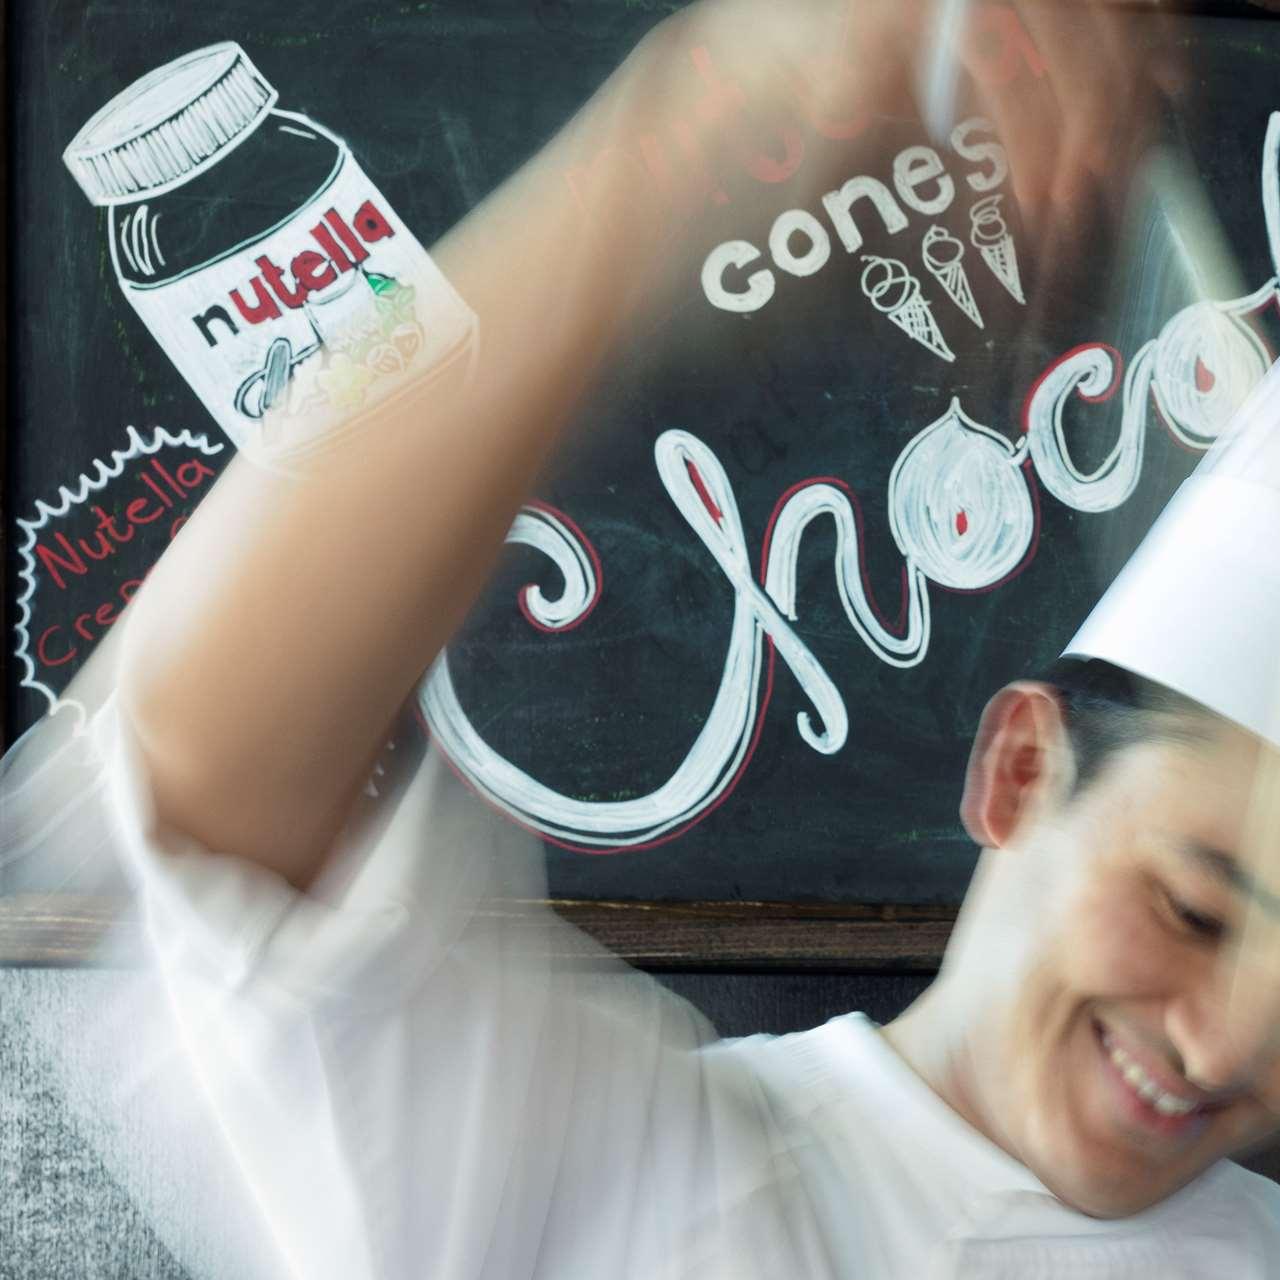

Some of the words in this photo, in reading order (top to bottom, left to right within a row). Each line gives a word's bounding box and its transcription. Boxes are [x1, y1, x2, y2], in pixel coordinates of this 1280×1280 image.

[193, 200, 396, 348] nutella
[701, 116, 1010, 313] cones
[36, 457, 216, 590] Nutella
